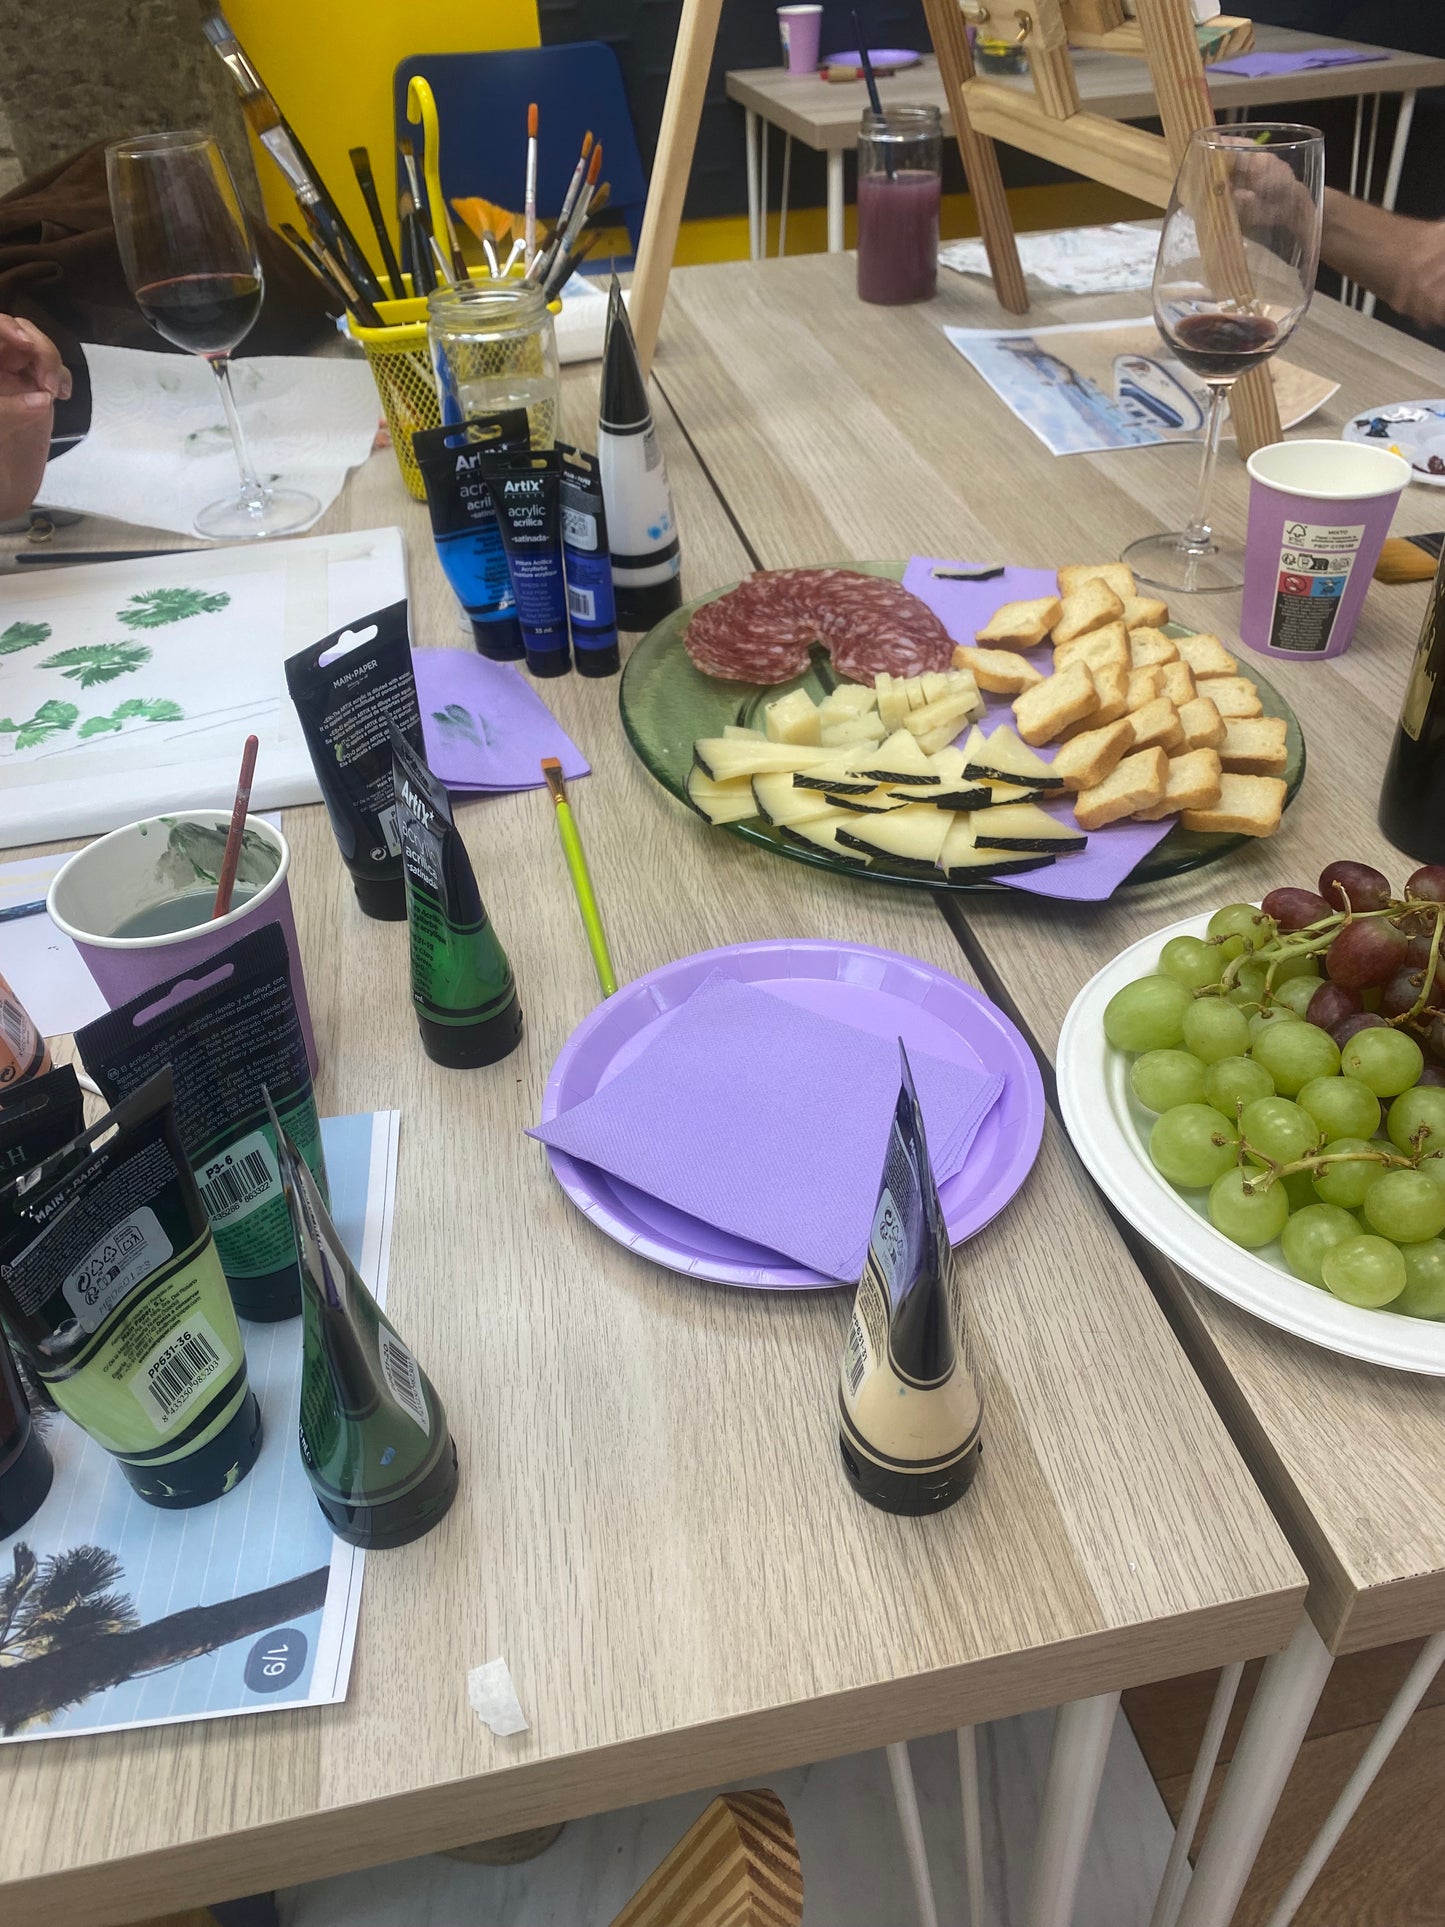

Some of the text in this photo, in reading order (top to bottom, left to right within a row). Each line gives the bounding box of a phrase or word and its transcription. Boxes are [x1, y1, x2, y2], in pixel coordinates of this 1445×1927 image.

[504, 481, 540, 492] Artix
[508, 505, 546, 518] acrylic
[402, 780, 429, 830] Artix
[271, 975, 284, 985] con
[33, 1192, 66, 1224] MAIN
[211, 1181, 269, 1222] 435286 863322
[121, 1325, 135, 1342] Main
[146, 1329, 193, 1379] PP631-36
[160, 1359, 220, 1423] 8 435250 985203
[262, 1644, 288, 1676] 1/9
